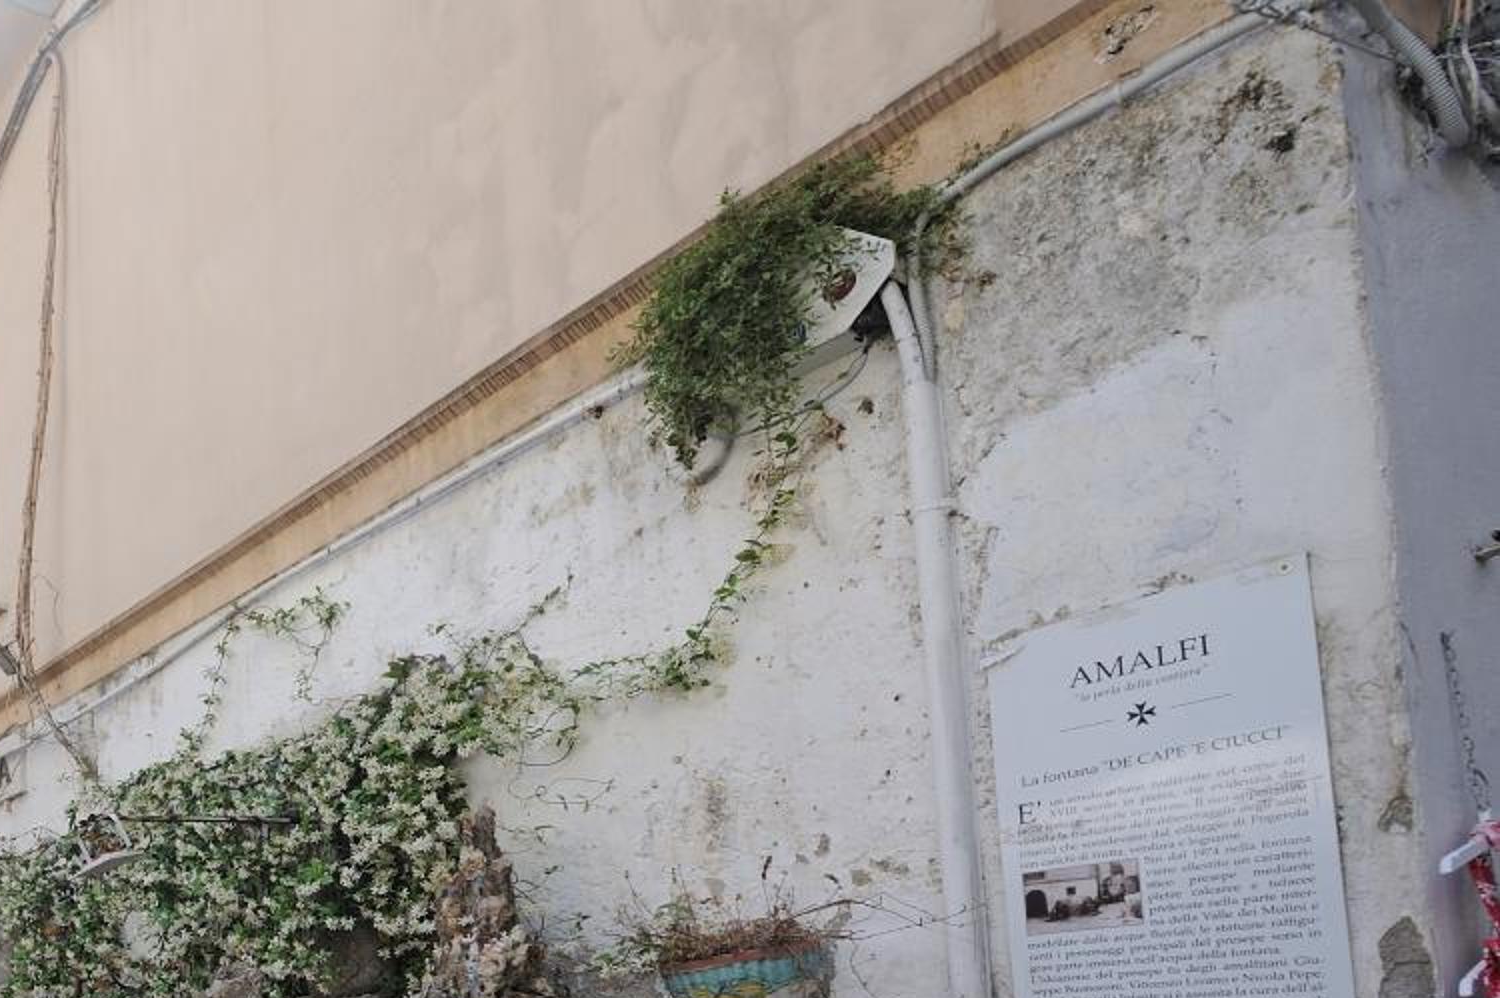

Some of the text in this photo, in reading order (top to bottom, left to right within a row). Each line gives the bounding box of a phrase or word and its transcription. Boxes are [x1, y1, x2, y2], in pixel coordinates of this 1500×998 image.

[1070, 633, 1210, 689] AMALFI
[1021, 775, 1039, 788] La
[1043, 766, 1099, 784] fontana
